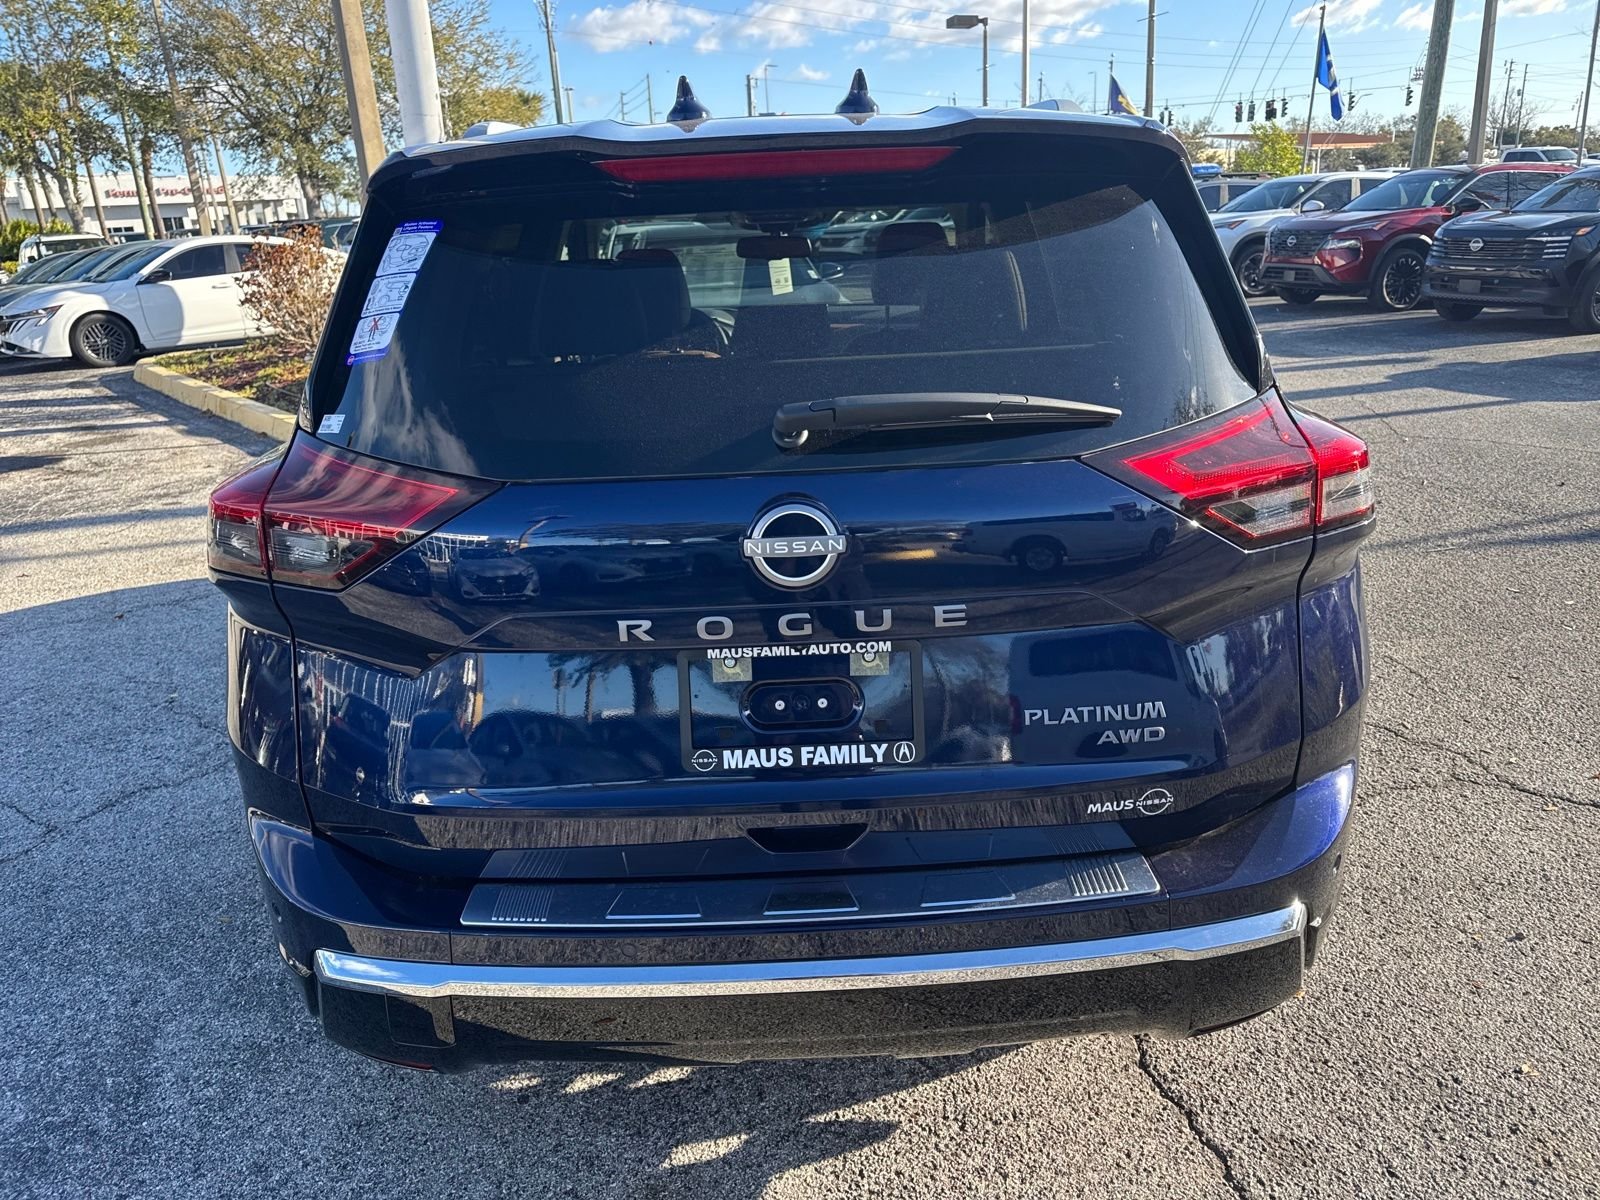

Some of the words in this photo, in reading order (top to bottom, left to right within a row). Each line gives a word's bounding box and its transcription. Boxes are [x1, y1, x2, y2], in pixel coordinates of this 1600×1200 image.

[747, 539, 843, 554] NISSAN
[616, 604, 968, 642] ROGUE
[1024, 701, 1167, 726] PLATINUM
[1096, 726, 1166, 746] AWD
[722, 748, 793, 769] MAUS
[800, 743, 888, 766] FAMILY
[1087, 800, 1134, 814] MAUS
[1136, 796, 1174, 807] NISSAN
